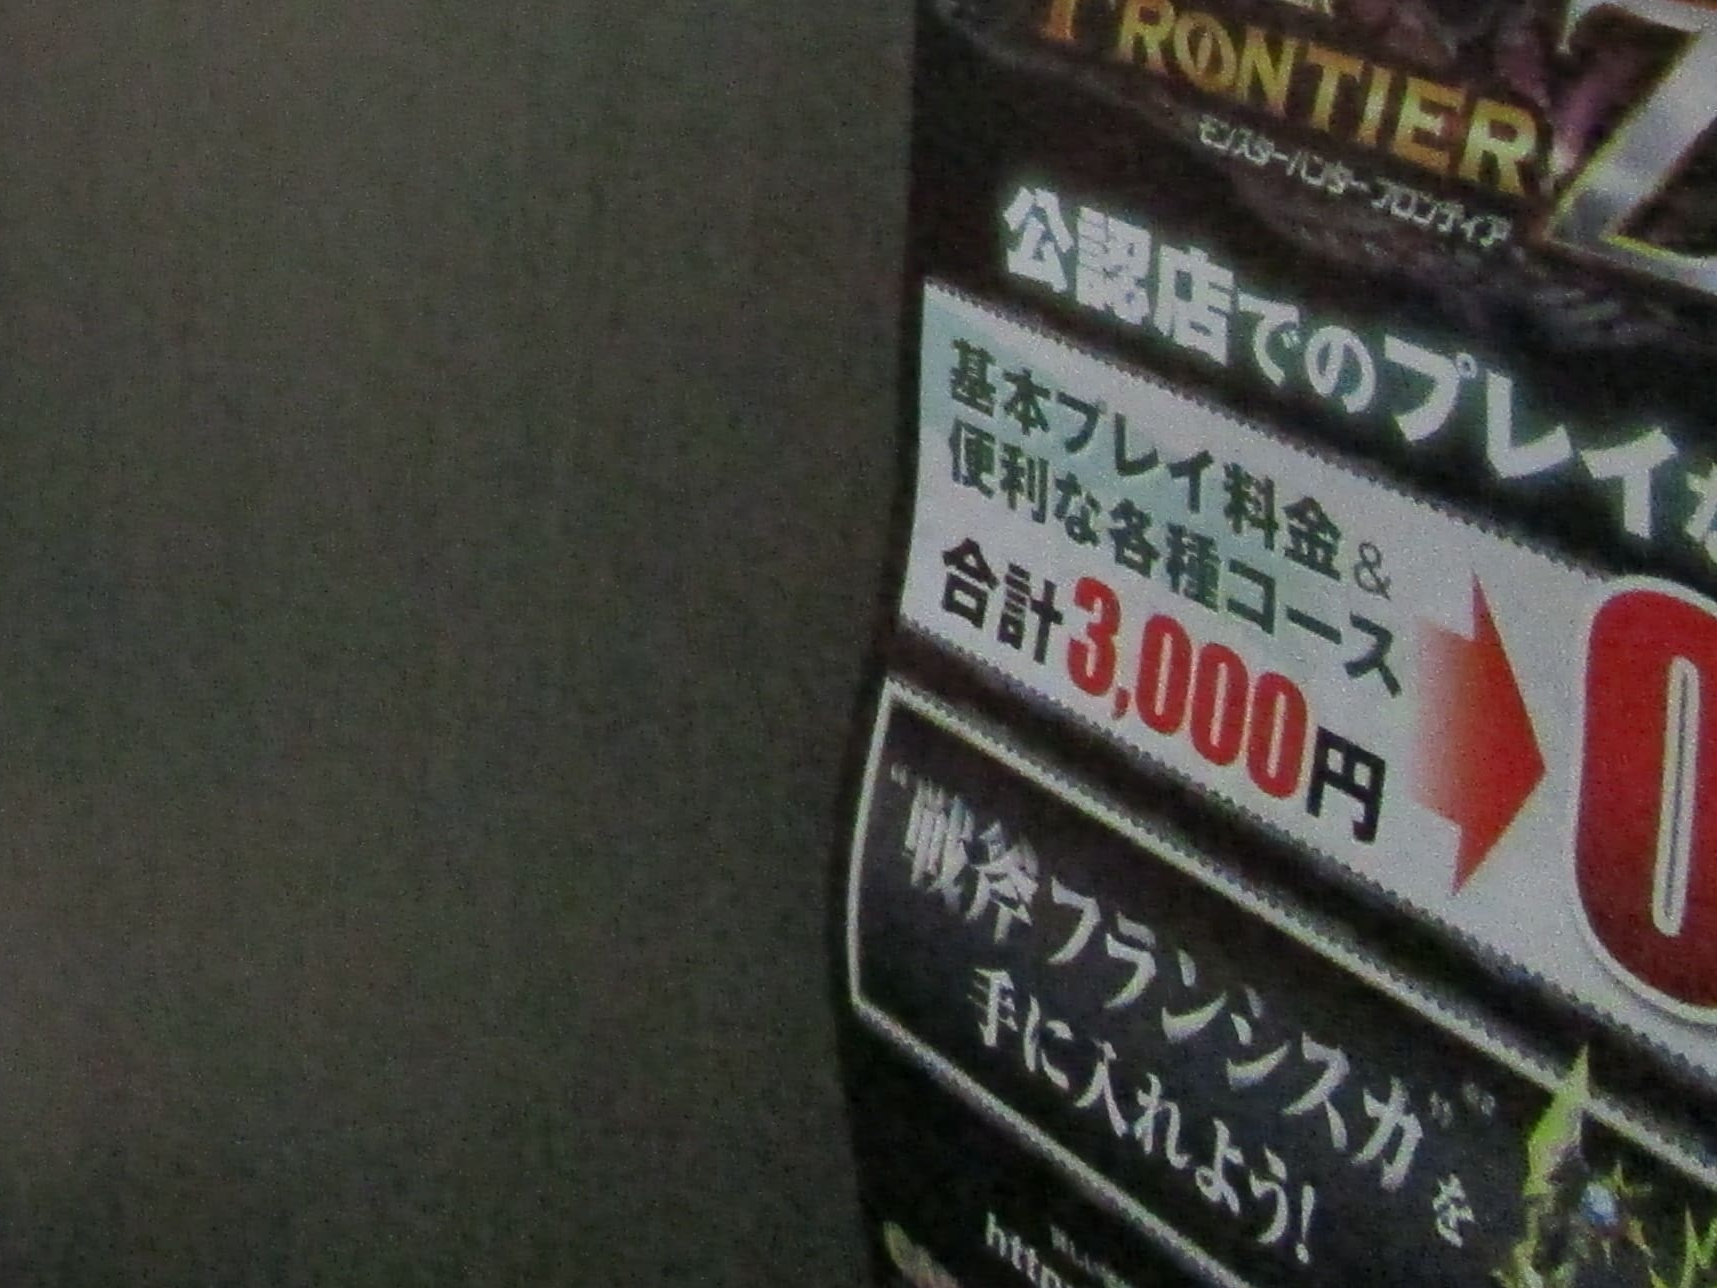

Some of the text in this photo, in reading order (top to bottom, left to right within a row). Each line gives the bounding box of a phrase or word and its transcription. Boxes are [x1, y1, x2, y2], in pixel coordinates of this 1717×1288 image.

[1003, 185, 1717, 564] 公認店でのプレイ
[941, 536, 1386, 843] 合計3,000円
[948, 417, 1403, 699] 便利な各種コース
